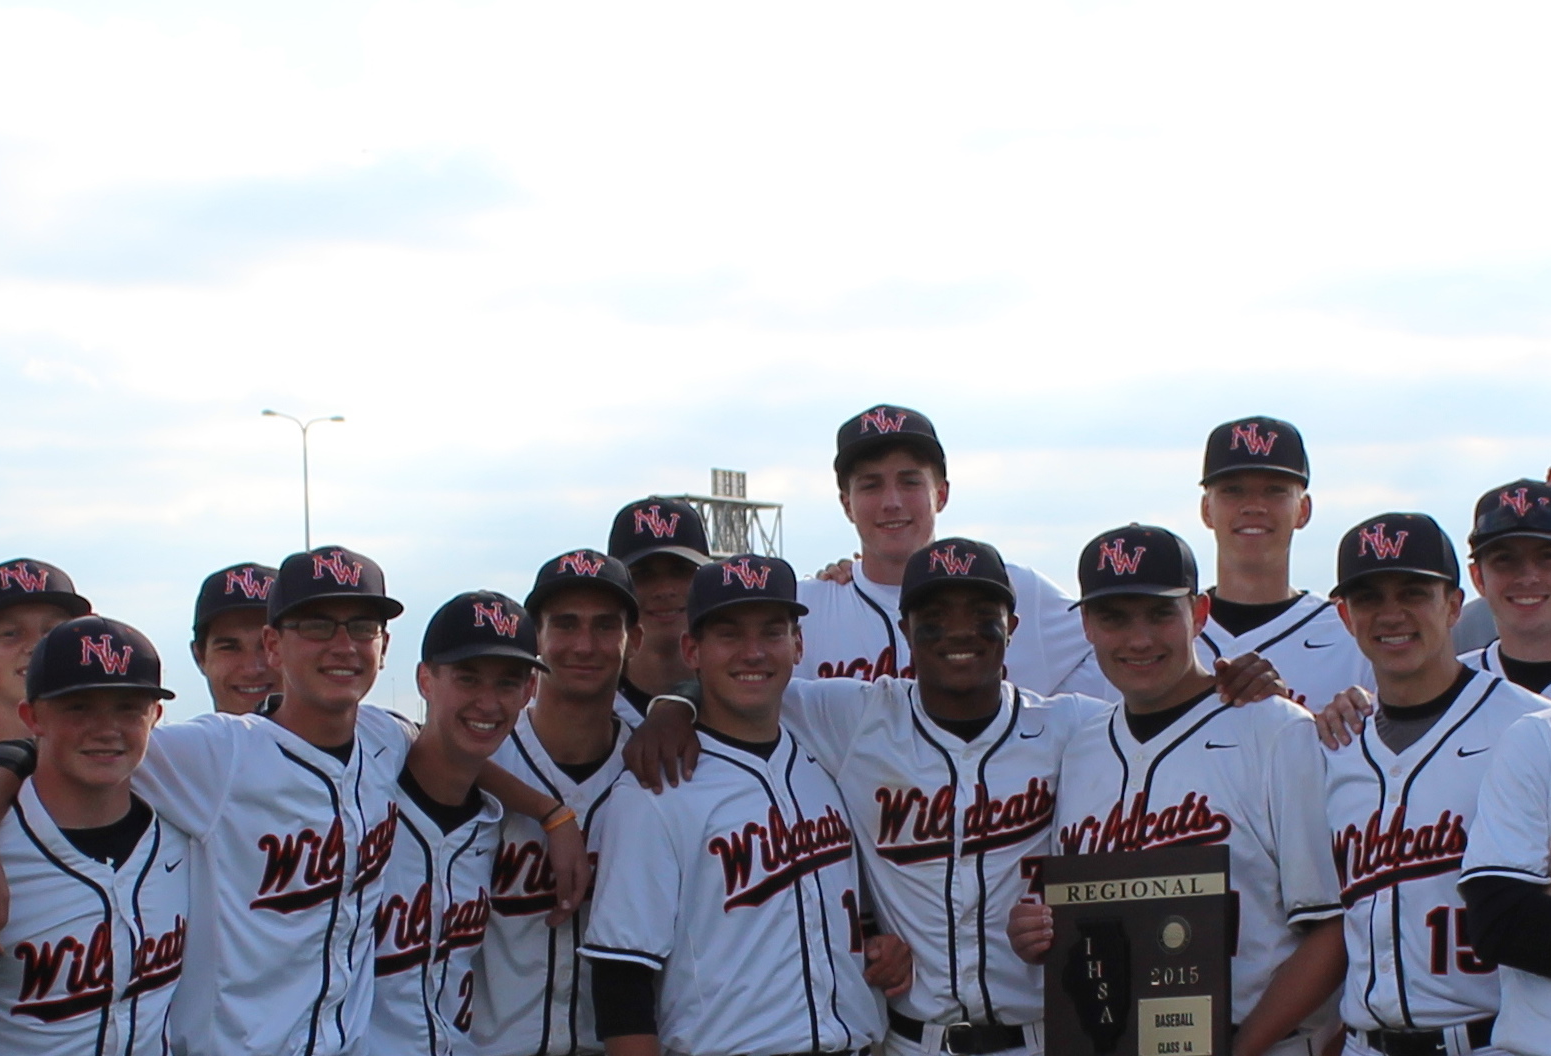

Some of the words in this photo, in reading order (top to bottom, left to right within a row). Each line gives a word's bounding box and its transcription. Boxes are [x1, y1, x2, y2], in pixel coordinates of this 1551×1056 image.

[860, 407, 907, 434] NW
[1230, 423, 1279, 457] NW
[633, 505, 681, 538] NW
[1096, 539, 1146, 575] NW
[1357, 523, 1409, 560] NW
[0, 562, 49, 592] NW
[311, 551, 364, 587] NW
[557, 551, 606, 577] NW
[721, 558, 771, 589] NW
[927, 545, 977, 576] NW
[225, 567, 275, 600] NW
[473, 602, 519, 638] NW
[80, 635, 133, 675] NW
[874, 776, 1055, 854] Wildcats
[1060, 791, 1231, 853] Wildcats
[1331, 805, 1468, 895] Wildcats
[1066, 877, 1204, 903] REGIONAL
[1425, 905, 1500, 976] 15
[1150, 965, 1200, 986] 2015
[1154, 1012, 1195, 1028] BASEBALL
[1157, 1041, 1180, 1054] CLASS
[1183, 1041, 1193, 1053] 4A
